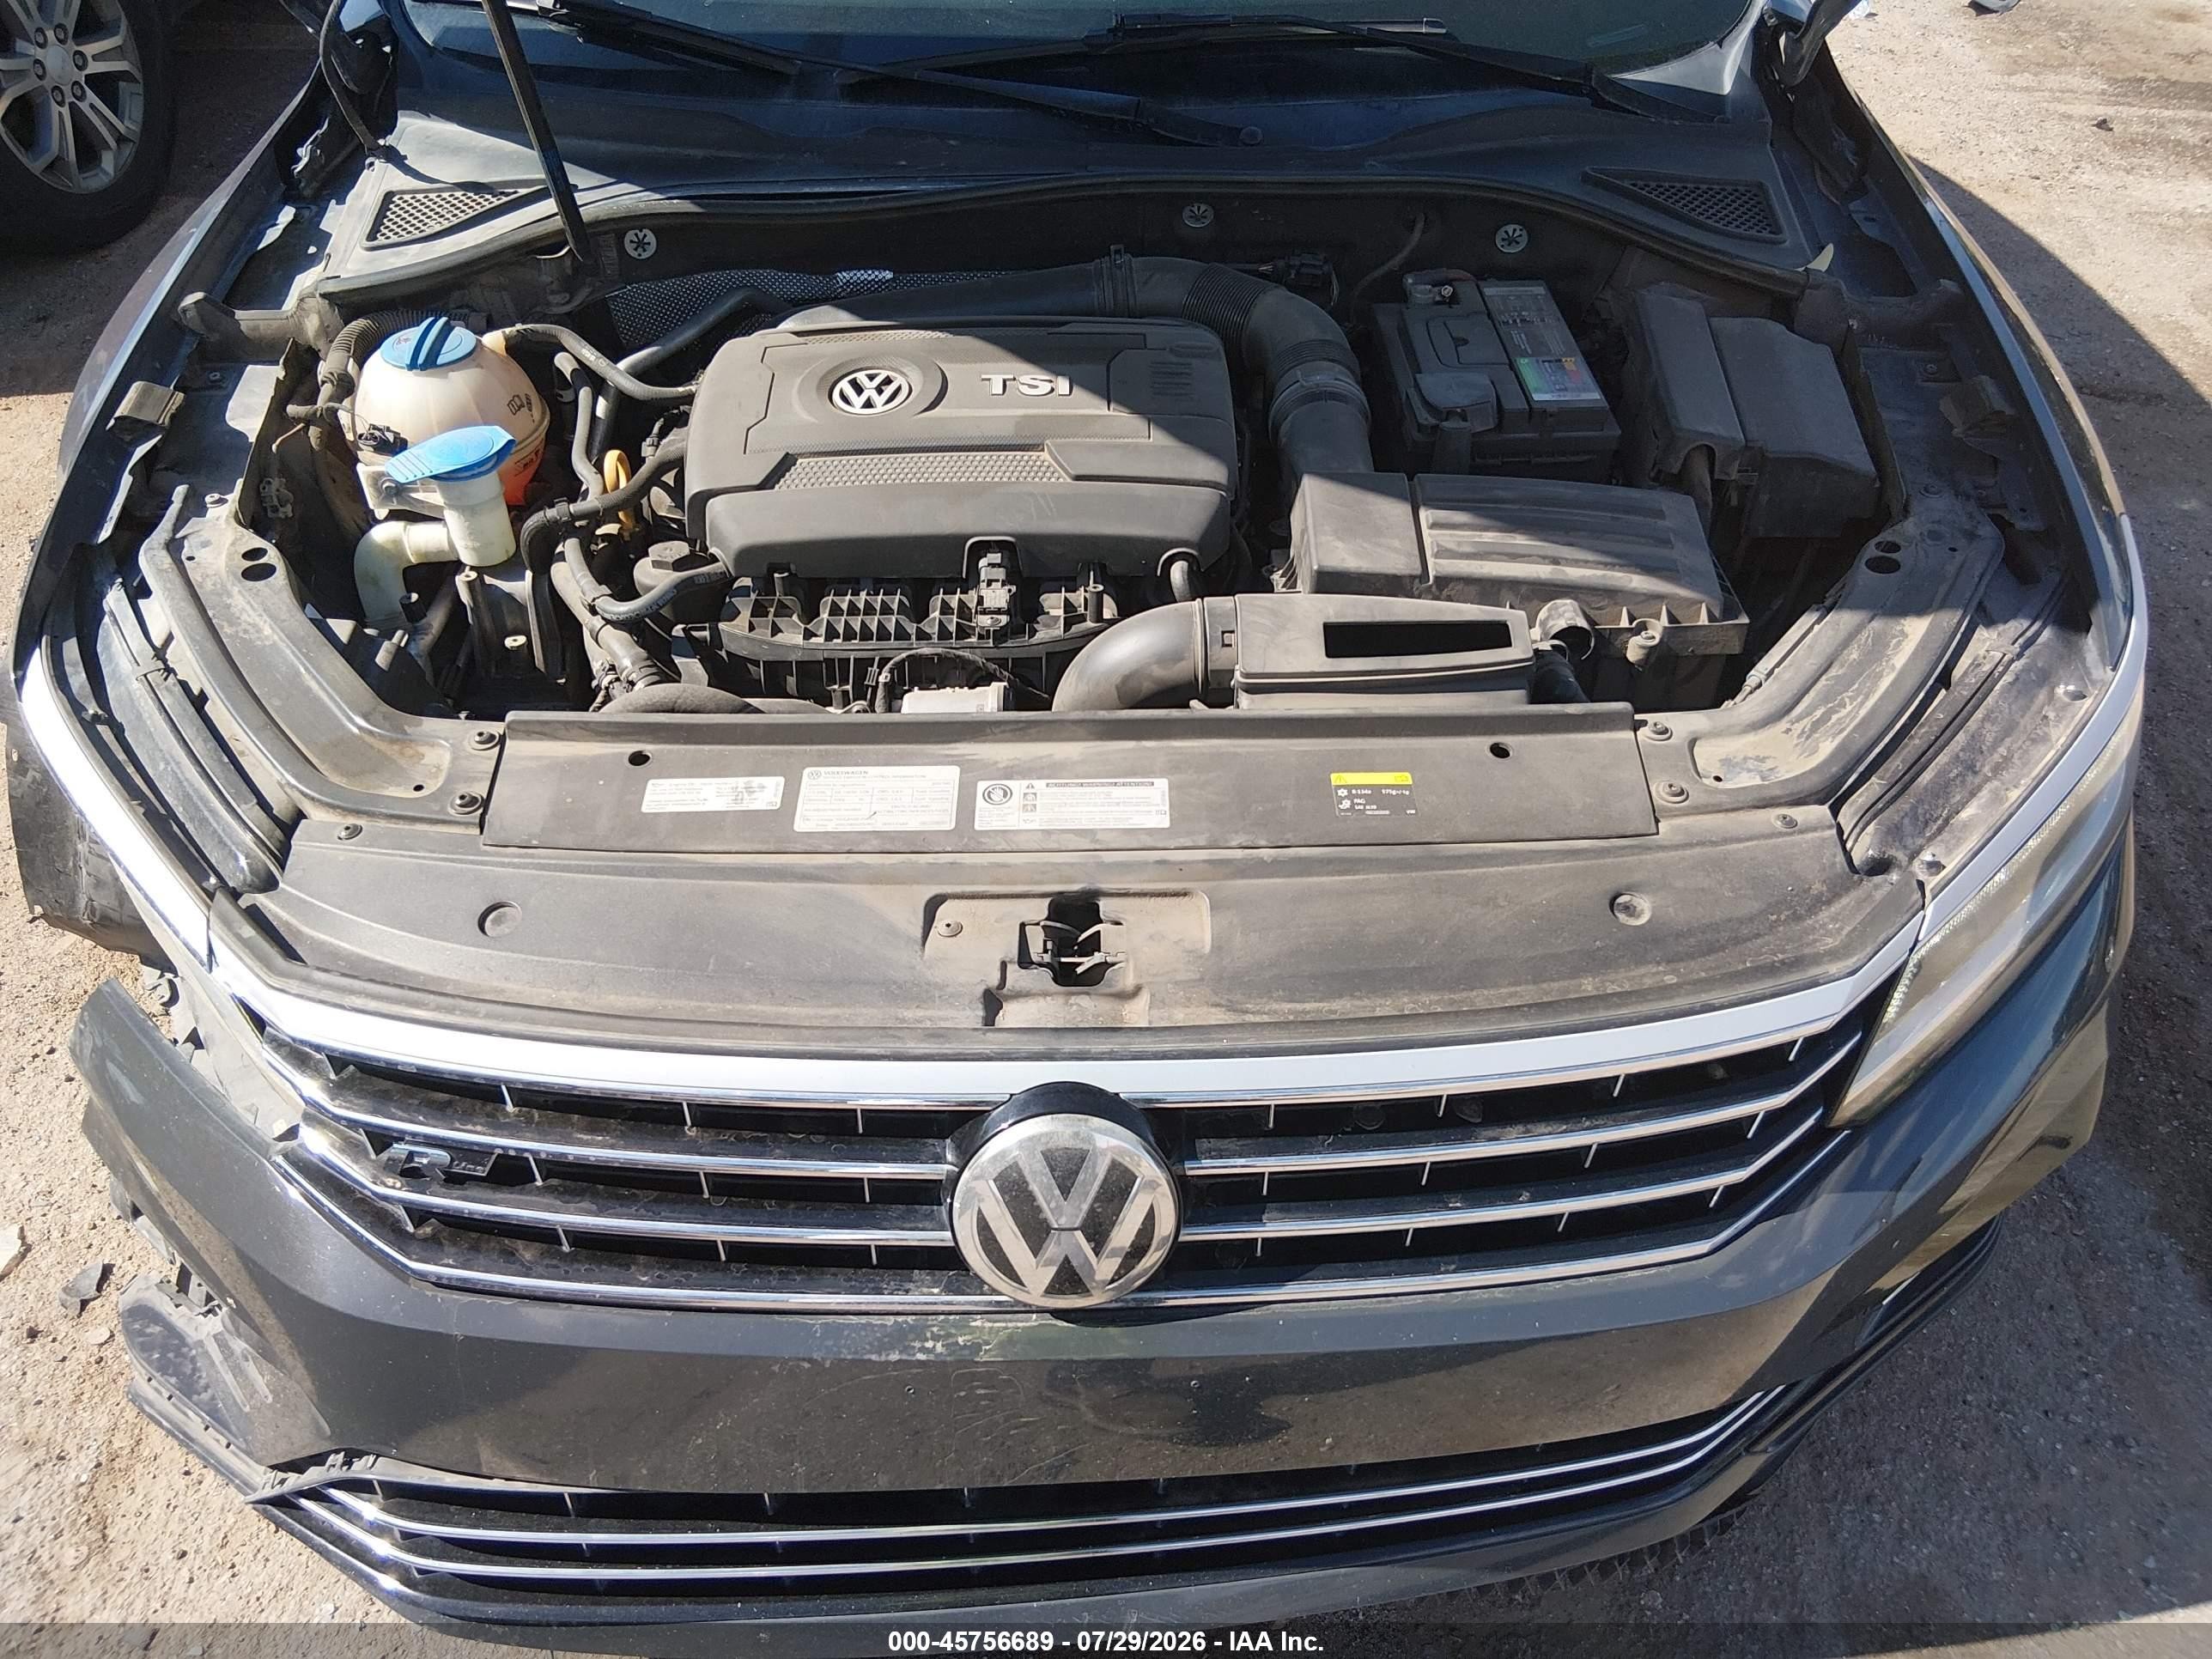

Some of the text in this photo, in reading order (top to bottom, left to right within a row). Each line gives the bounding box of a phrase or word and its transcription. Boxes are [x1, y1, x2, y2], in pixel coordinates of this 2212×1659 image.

[830, 368, 910, 415] VW
[981, 374, 1073, 396] TSI
[953, 1114, 1178, 1309] VW
